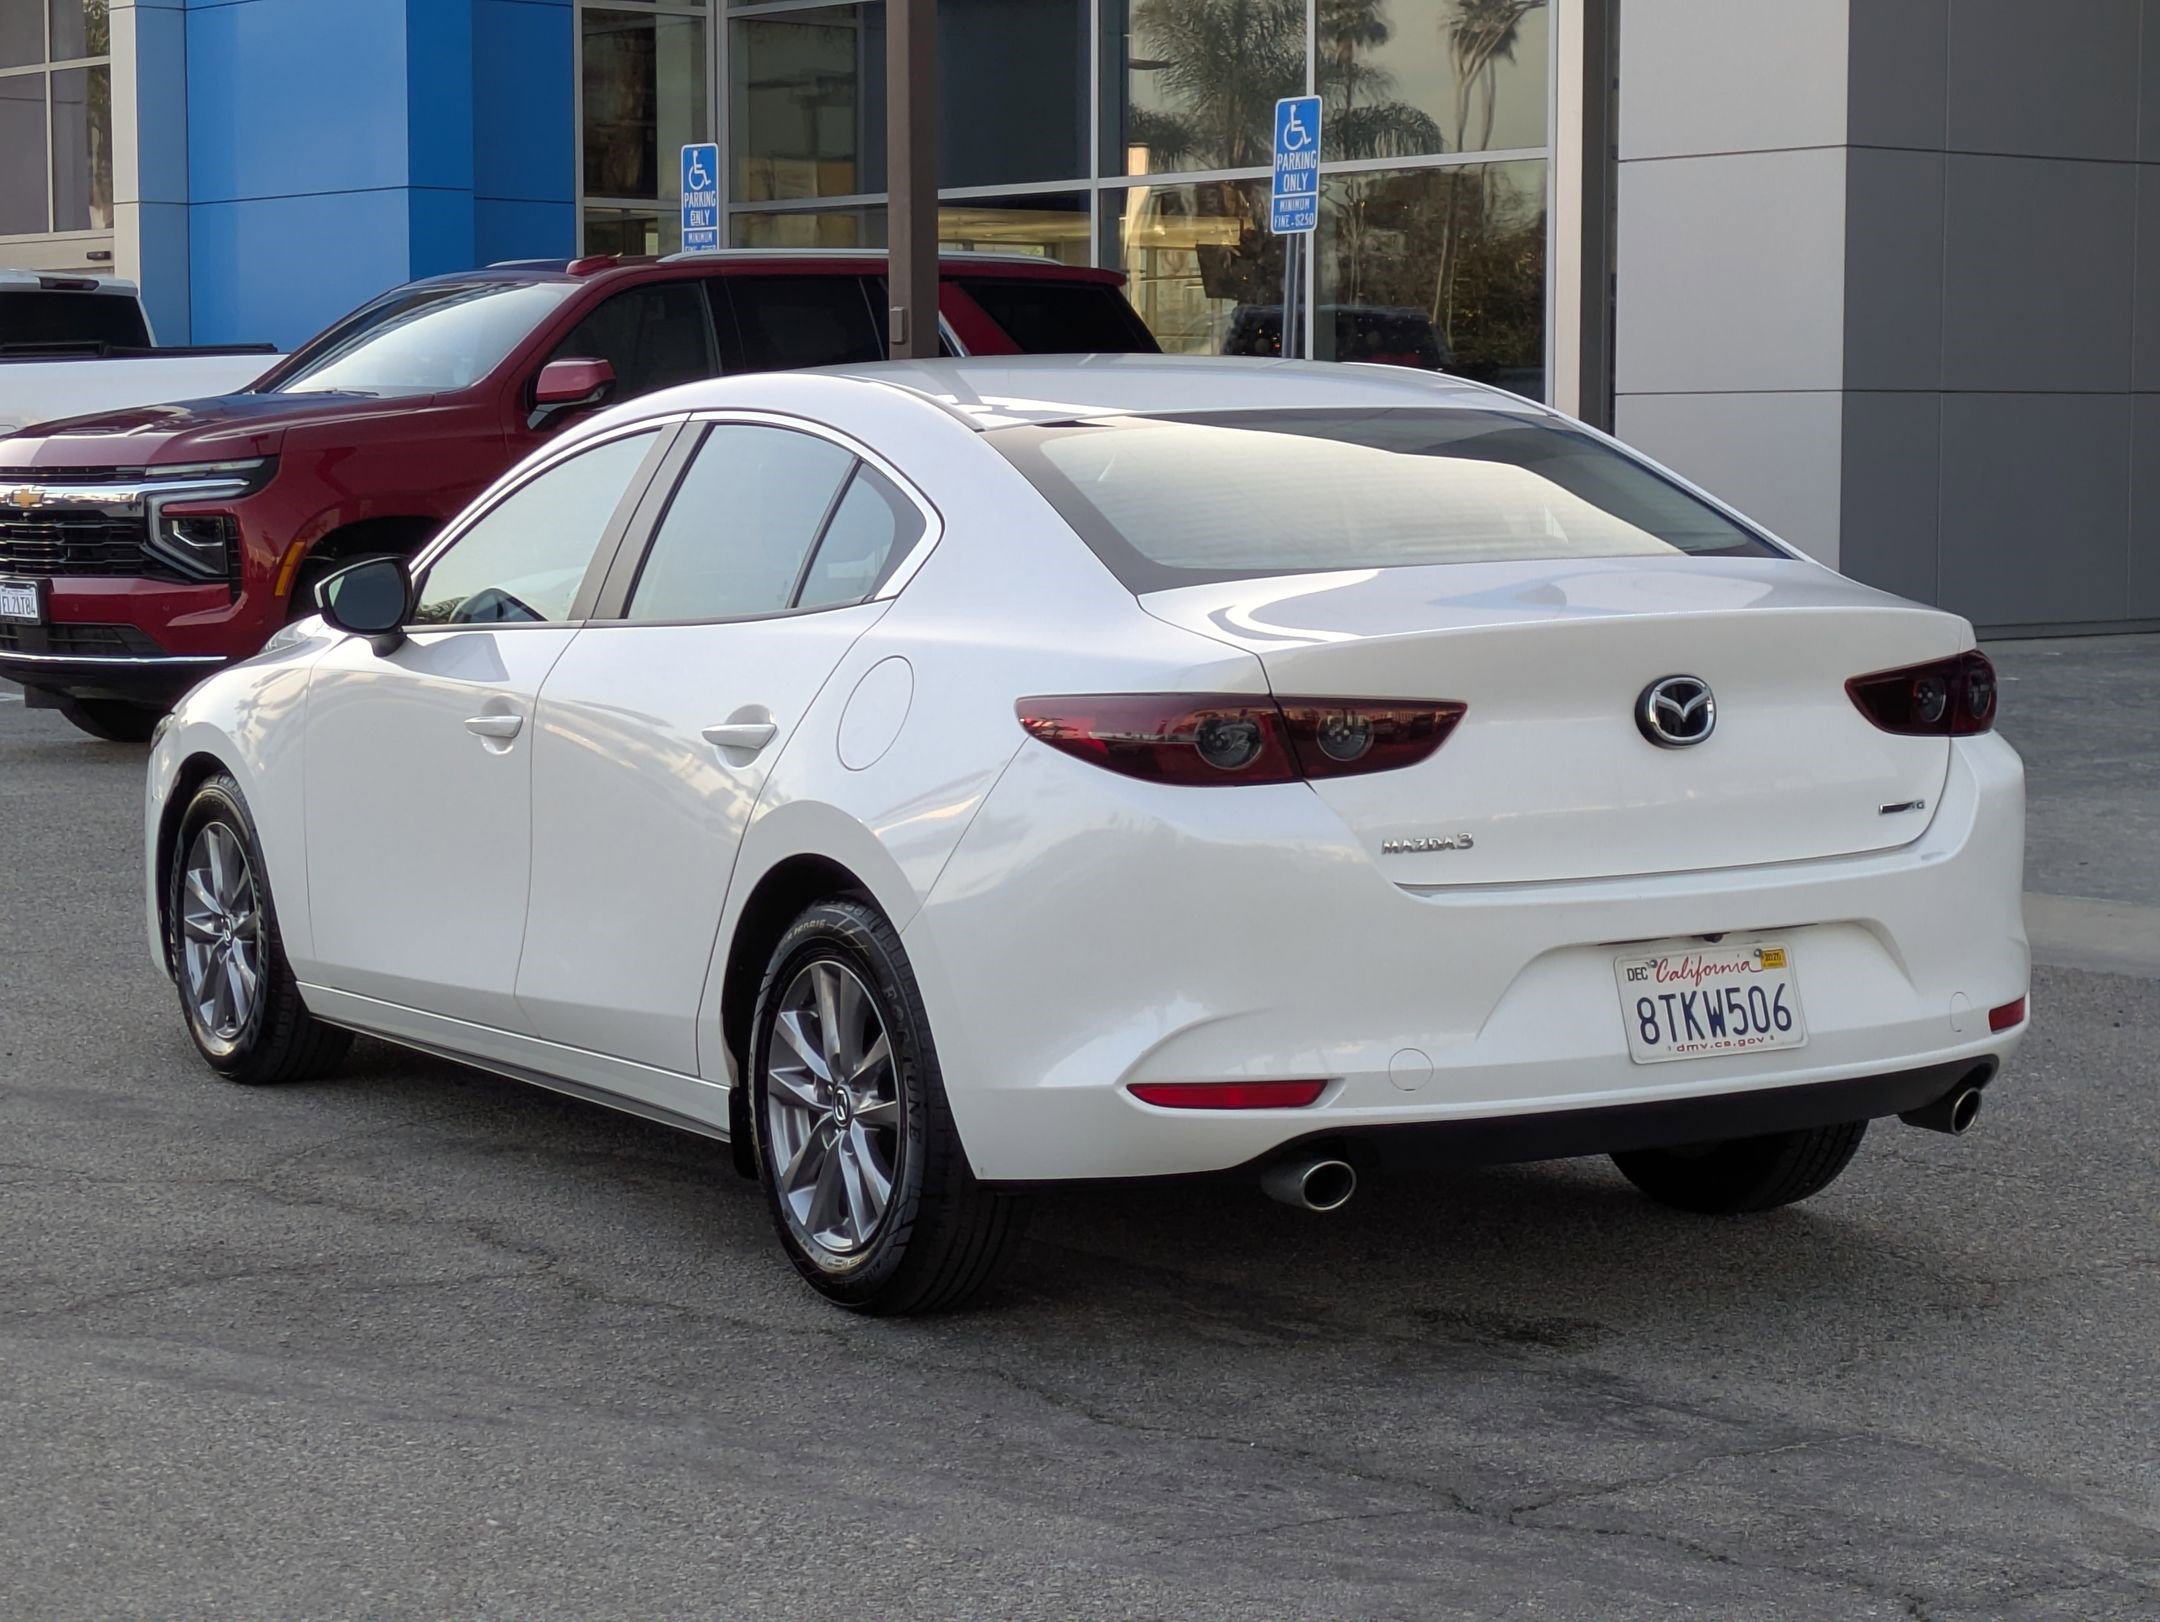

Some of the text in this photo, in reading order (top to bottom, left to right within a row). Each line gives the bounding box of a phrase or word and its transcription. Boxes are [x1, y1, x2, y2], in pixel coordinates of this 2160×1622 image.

[1276, 150, 1317, 172] PARKING
[1283, 172, 1309, 192] ONLY
[684, 190, 716, 208] PARKING
[1280, 198, 1310, 212] MINIMUM
[690, 210, 711, 226] ONLY
[1274, 214, 1290, 228] FINE
[688, 232, 713, 244] MINIMUM
[1381, 832, 1474, 855] MAZDA3
[1626, 954, 1764, 987] DEC California
[1636, 983, 1793, 1045] 8TKW506
[1676, 1035, 1766, 1053] dmv.ca.gov
